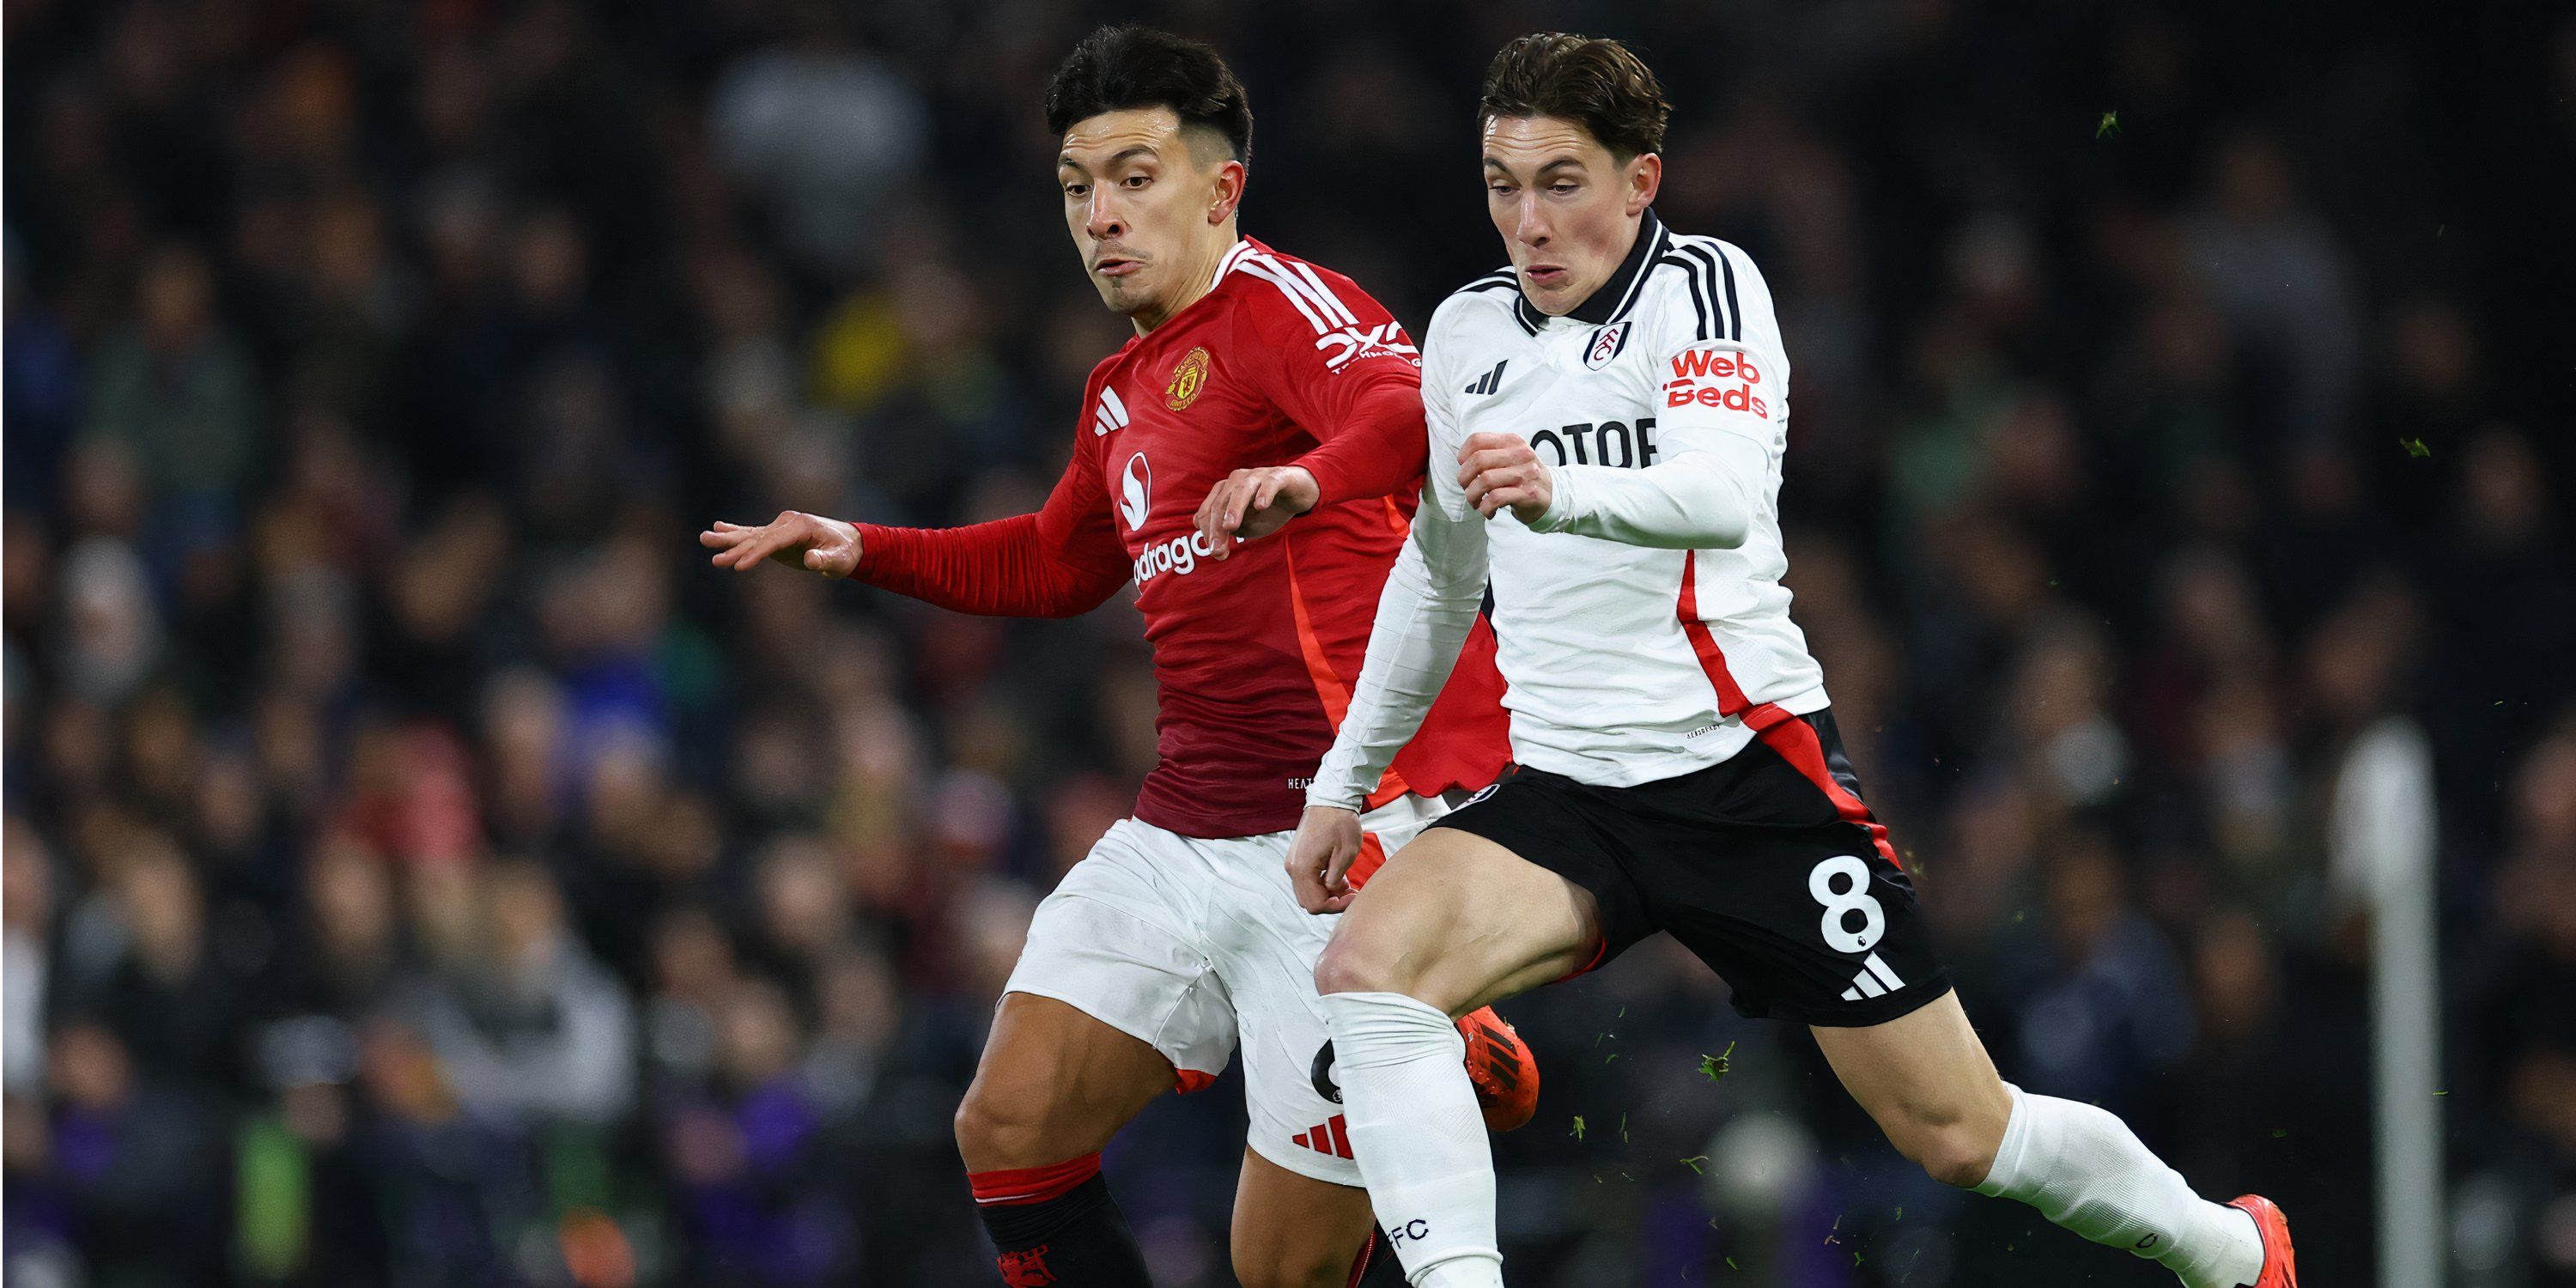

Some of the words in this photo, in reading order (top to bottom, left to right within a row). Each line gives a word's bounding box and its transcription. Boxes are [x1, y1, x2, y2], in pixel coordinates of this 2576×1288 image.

[1671, 349, 1760, 384] Web
[1668, 379, 1768, 419] Beds
[1808, 855, 1886, 953] 8
[1387, 1218, 1429, 1249] FC
